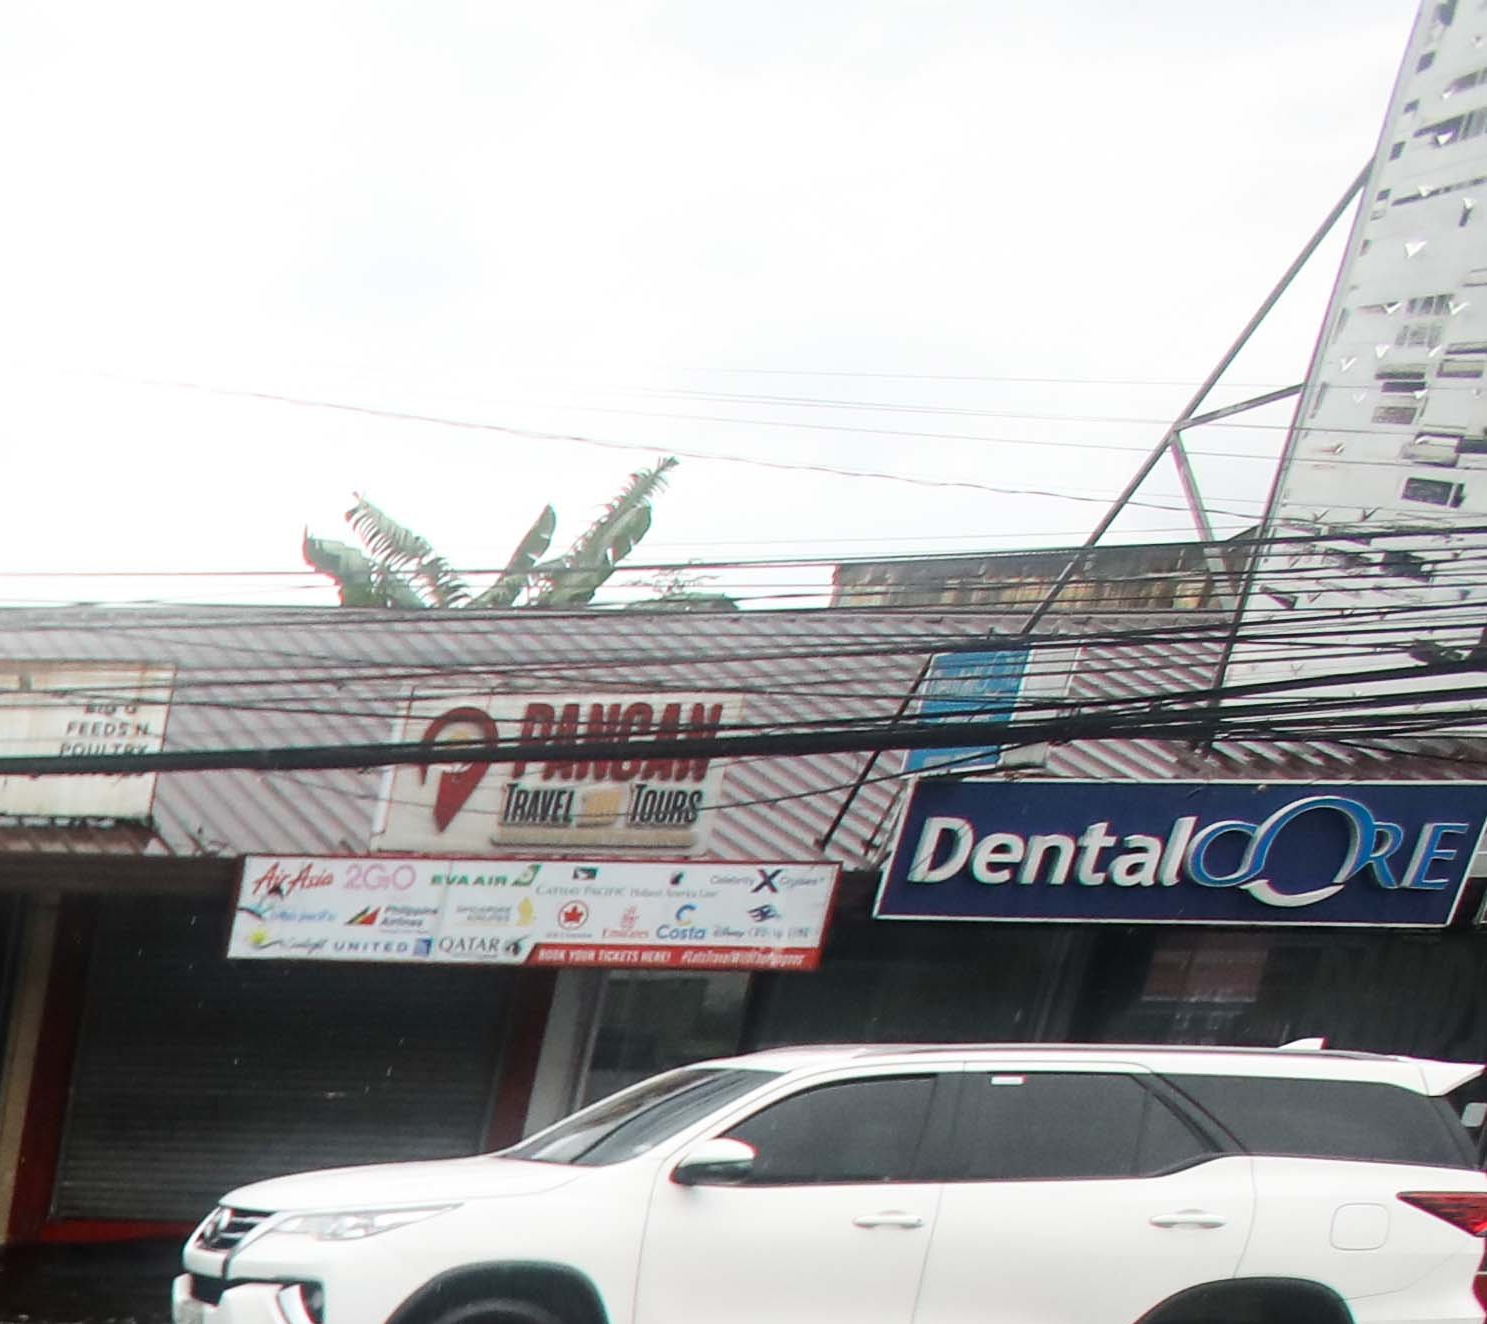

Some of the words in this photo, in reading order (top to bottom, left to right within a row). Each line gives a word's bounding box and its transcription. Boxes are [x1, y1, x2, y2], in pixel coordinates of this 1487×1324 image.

[503, 783, 575, 824] TRAVEL
[628, 783, 704, 824] TOURS
[431, 873, 469, 886] EVA
[472, 873, 508, 887] AIR
[655, 923, 707, 941] Costa
[333, 941, 409, 952] UNITED
[437, 935, 501, 953] QATAR
